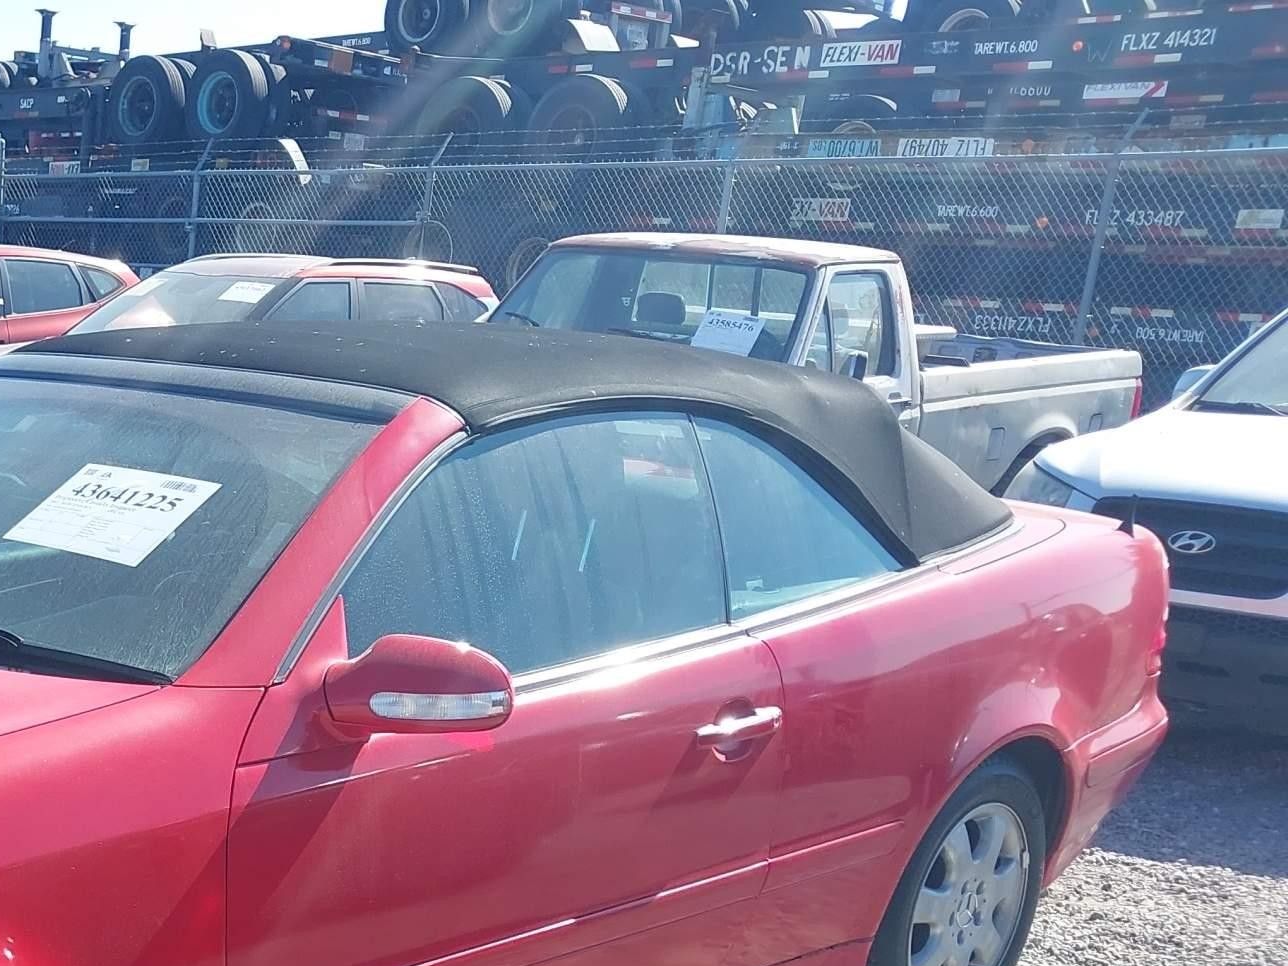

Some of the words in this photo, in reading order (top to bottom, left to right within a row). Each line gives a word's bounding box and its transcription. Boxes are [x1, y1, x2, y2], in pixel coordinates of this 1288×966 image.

[1121, 32, 1160, 51] FLXZ
[1163, 28, 1217, 47] 414321
[823, 43, 900, 63] FLEXI-VAN
[1085, 210, 1120, 225] FLZ
[1126, 210, 1185, 226] 433487
[71, 482, 185, 513] 43641225
